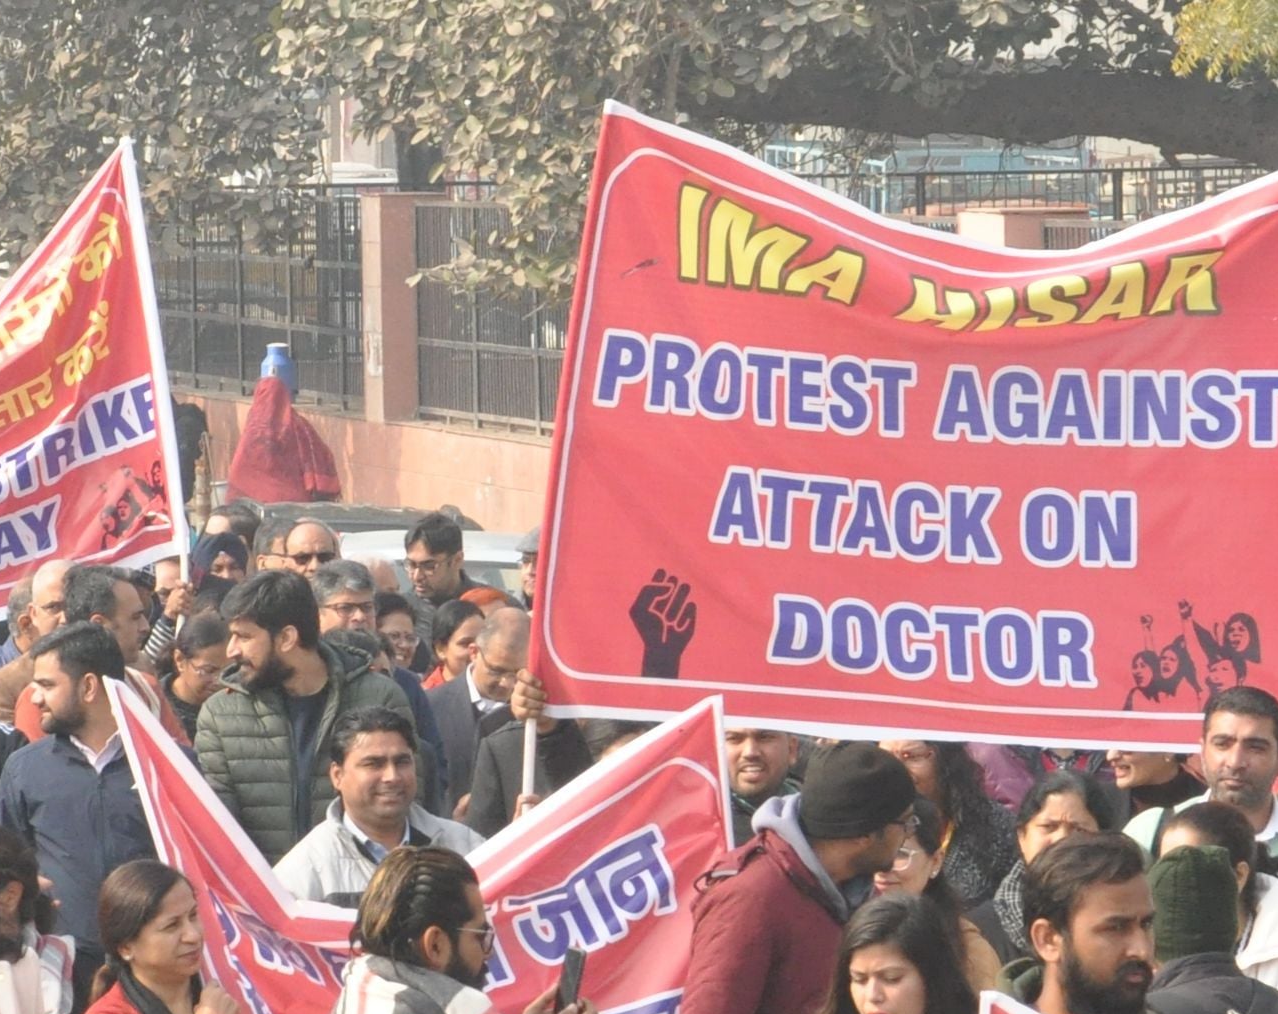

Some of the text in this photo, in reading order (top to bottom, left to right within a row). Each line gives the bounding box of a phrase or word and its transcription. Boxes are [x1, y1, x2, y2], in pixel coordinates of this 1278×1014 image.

[677, 182, 1224, 333] IMA HISAR
[601, 336, 913, 436] PROTEST
[712, 469, 1134, 563] ATTACK ON
[770, 598, 1094, 685] DOCTOR
[505, 823, 678, 966] जान
